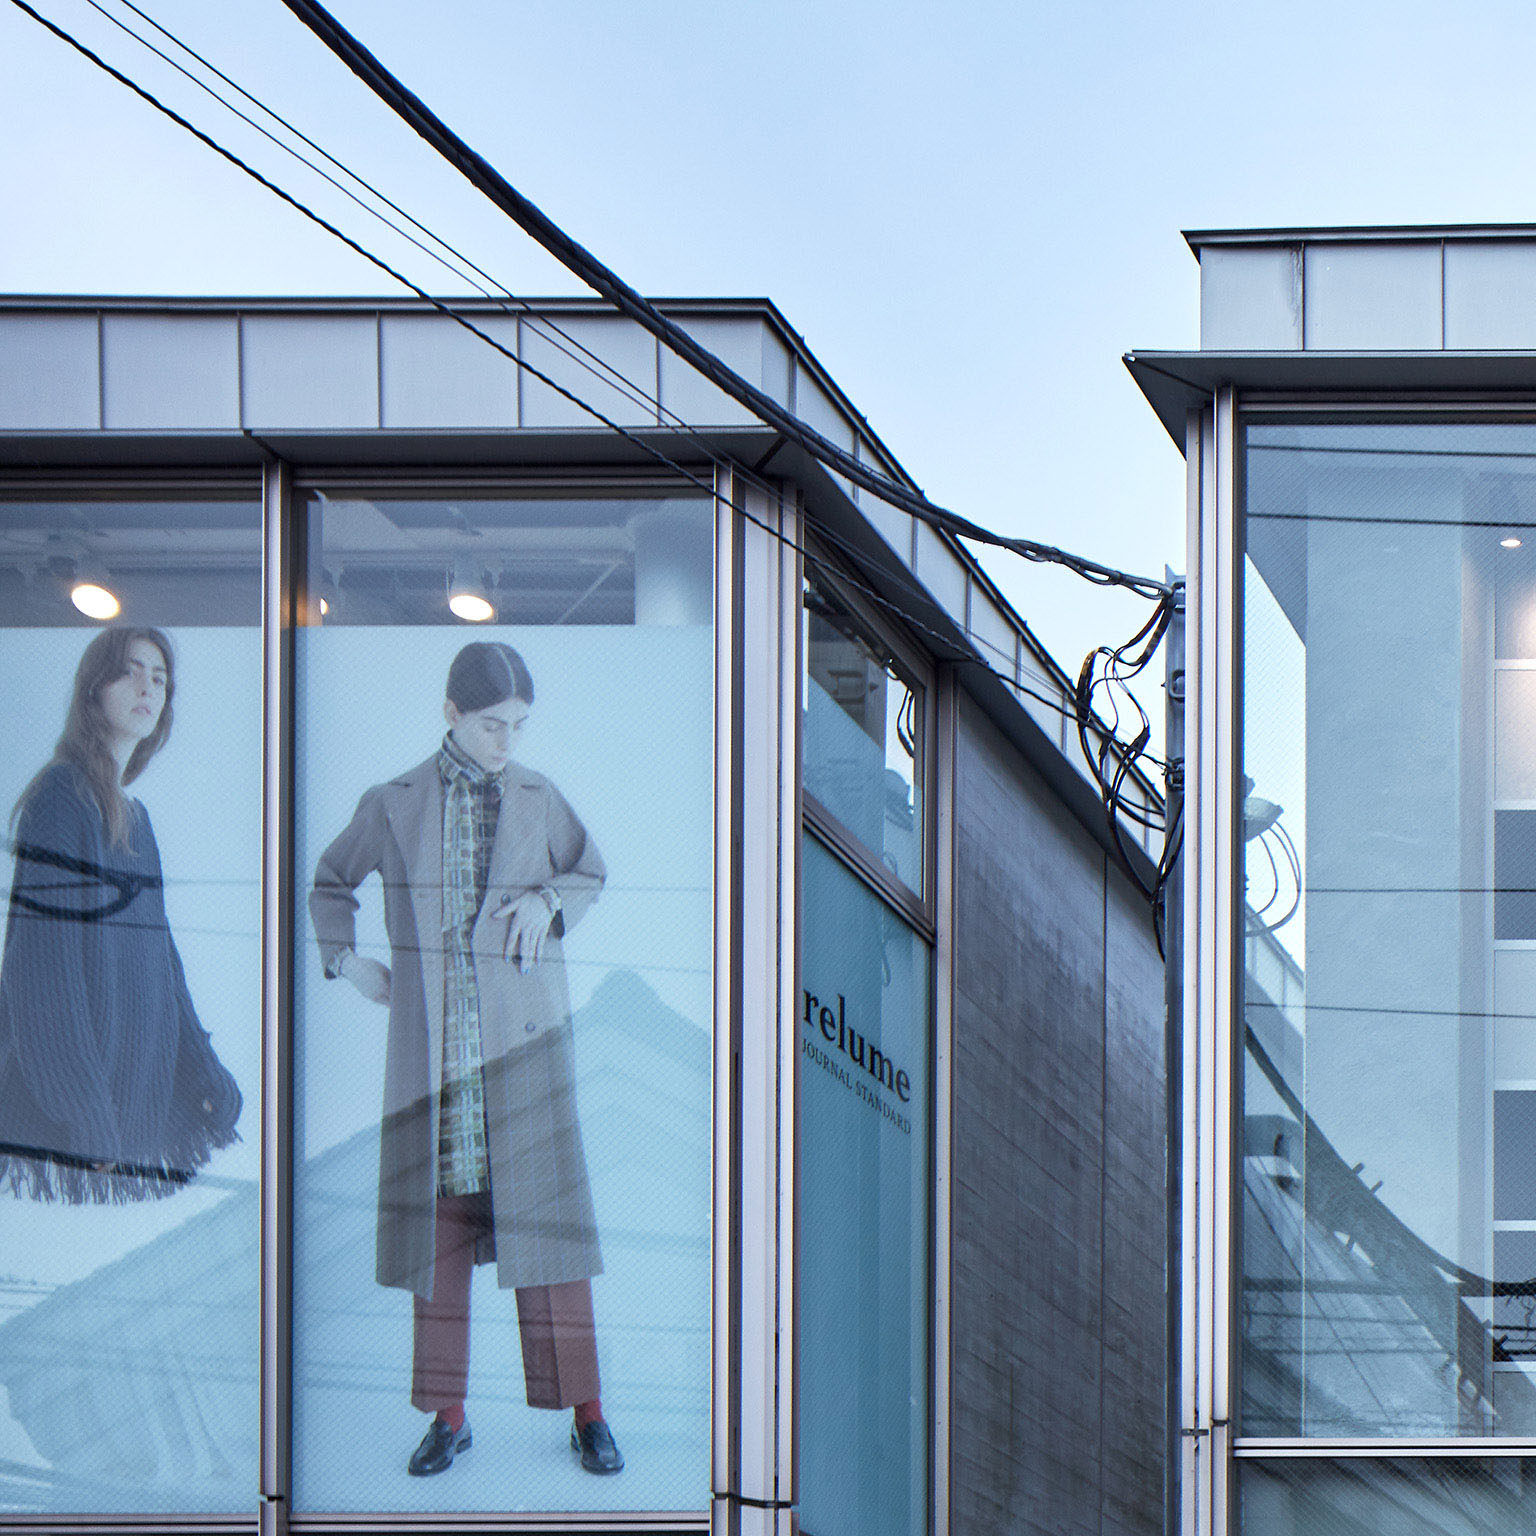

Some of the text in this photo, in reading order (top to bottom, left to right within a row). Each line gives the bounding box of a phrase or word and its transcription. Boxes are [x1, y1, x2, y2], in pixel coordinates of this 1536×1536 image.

[803, 988, 911, 1102] relume
[803, 1038, 911, 1134] JOURNAL STANDARD
